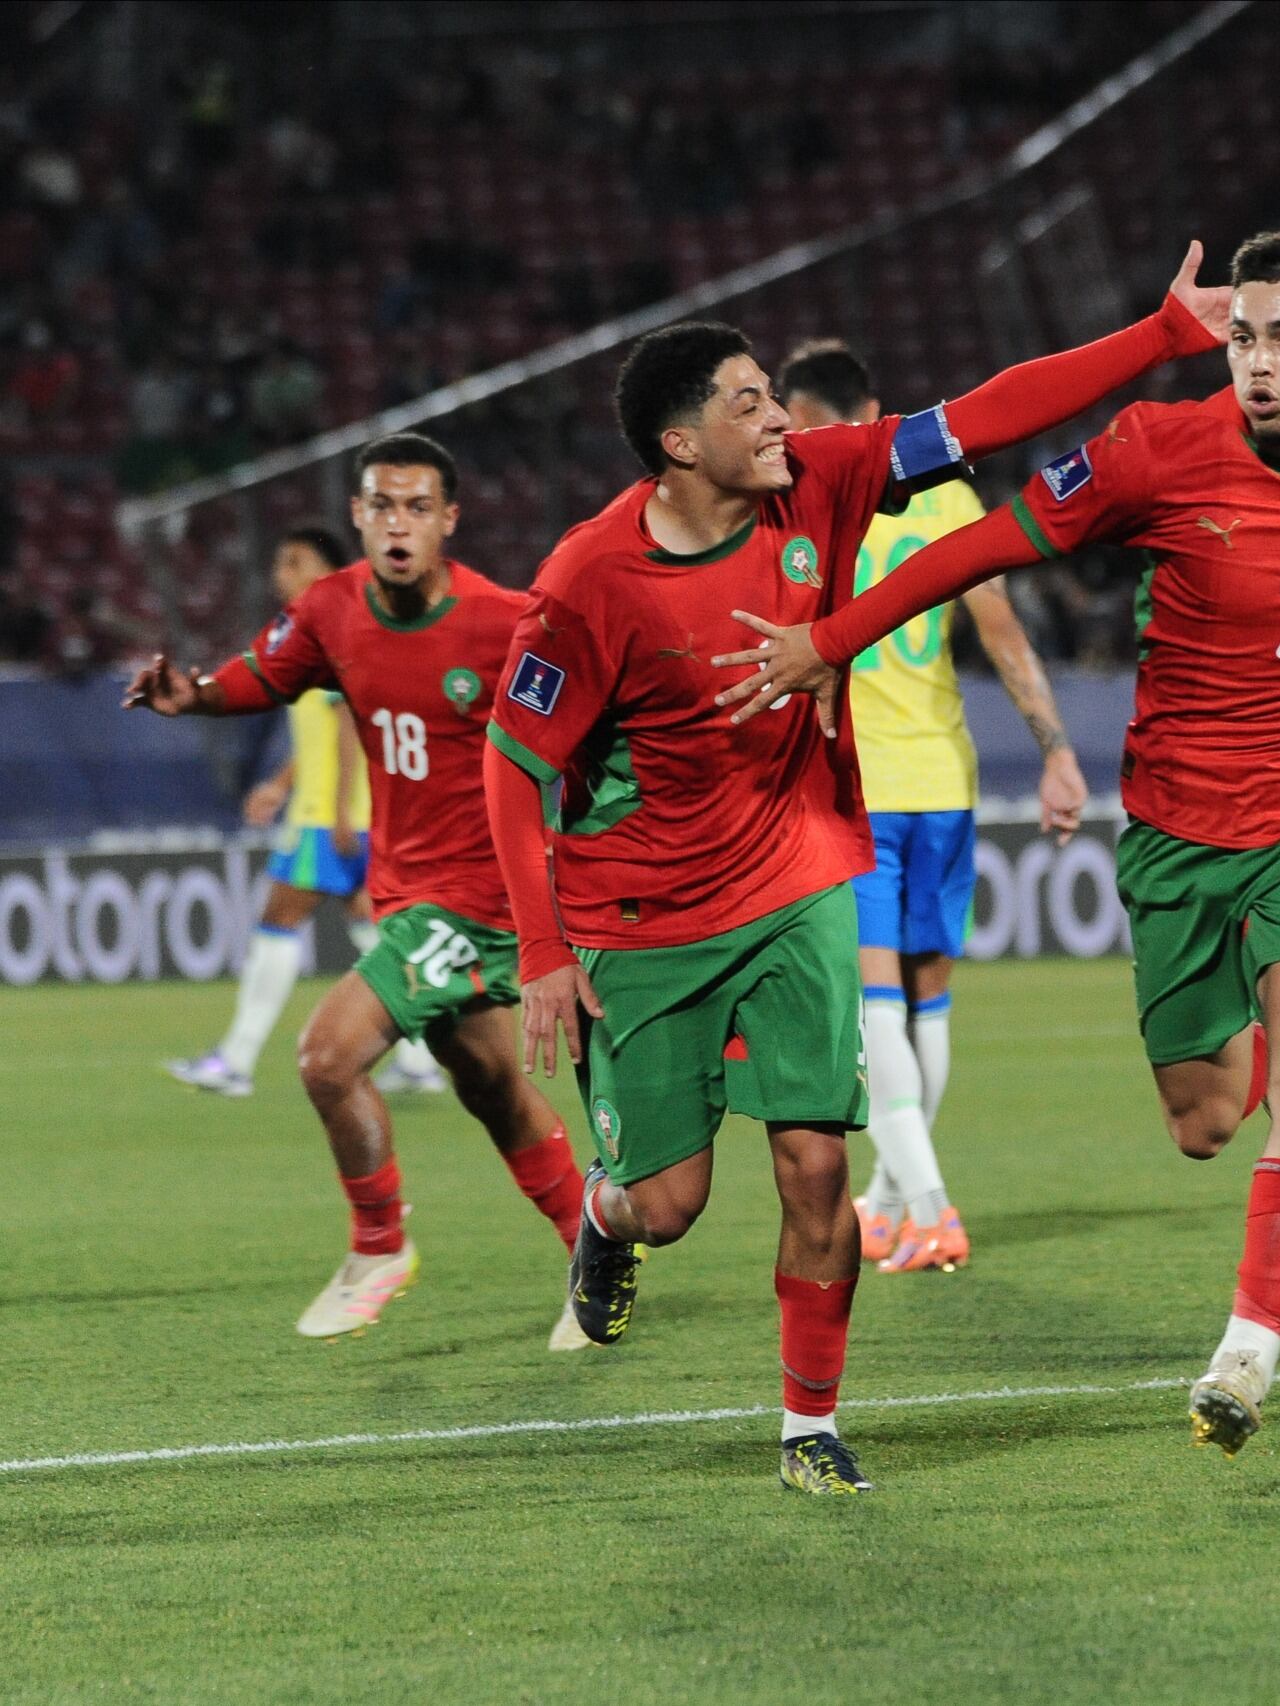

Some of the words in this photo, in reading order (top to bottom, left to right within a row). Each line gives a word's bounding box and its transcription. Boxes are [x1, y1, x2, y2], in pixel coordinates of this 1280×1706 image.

[372, 707, 429, 781] 18
[0, 845, 317, 984] otorol
[966, 820, 1134, 959] oro
[407, 918, 479, 988] 18
